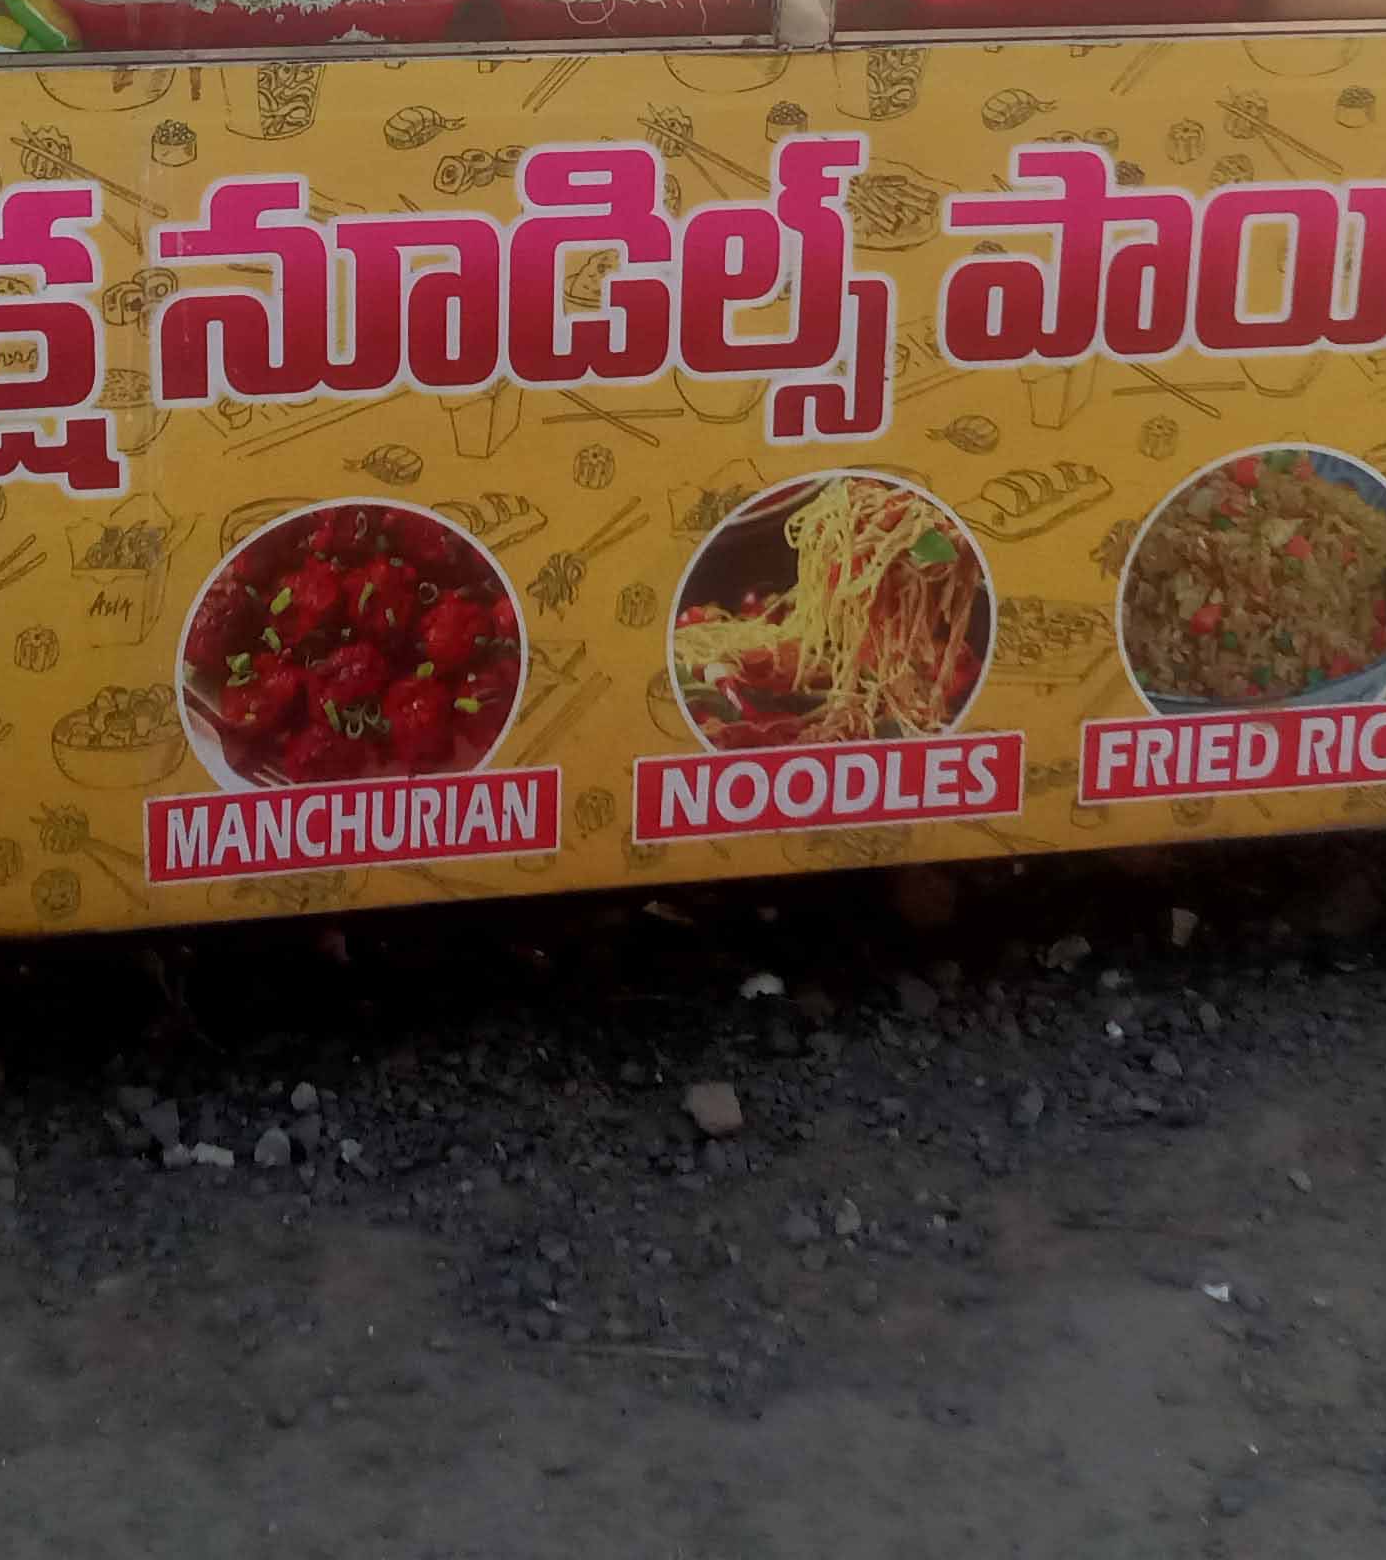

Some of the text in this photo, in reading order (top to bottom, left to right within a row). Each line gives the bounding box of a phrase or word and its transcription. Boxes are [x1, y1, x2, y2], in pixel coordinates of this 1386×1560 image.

[159, 140, 889, 436] నూడిల్స్
[658, 743, 998, 829] NOODLES
[1094, 717, 1277, 794] FRIED
[166, 780, 539, 870] MANCHURIAN
